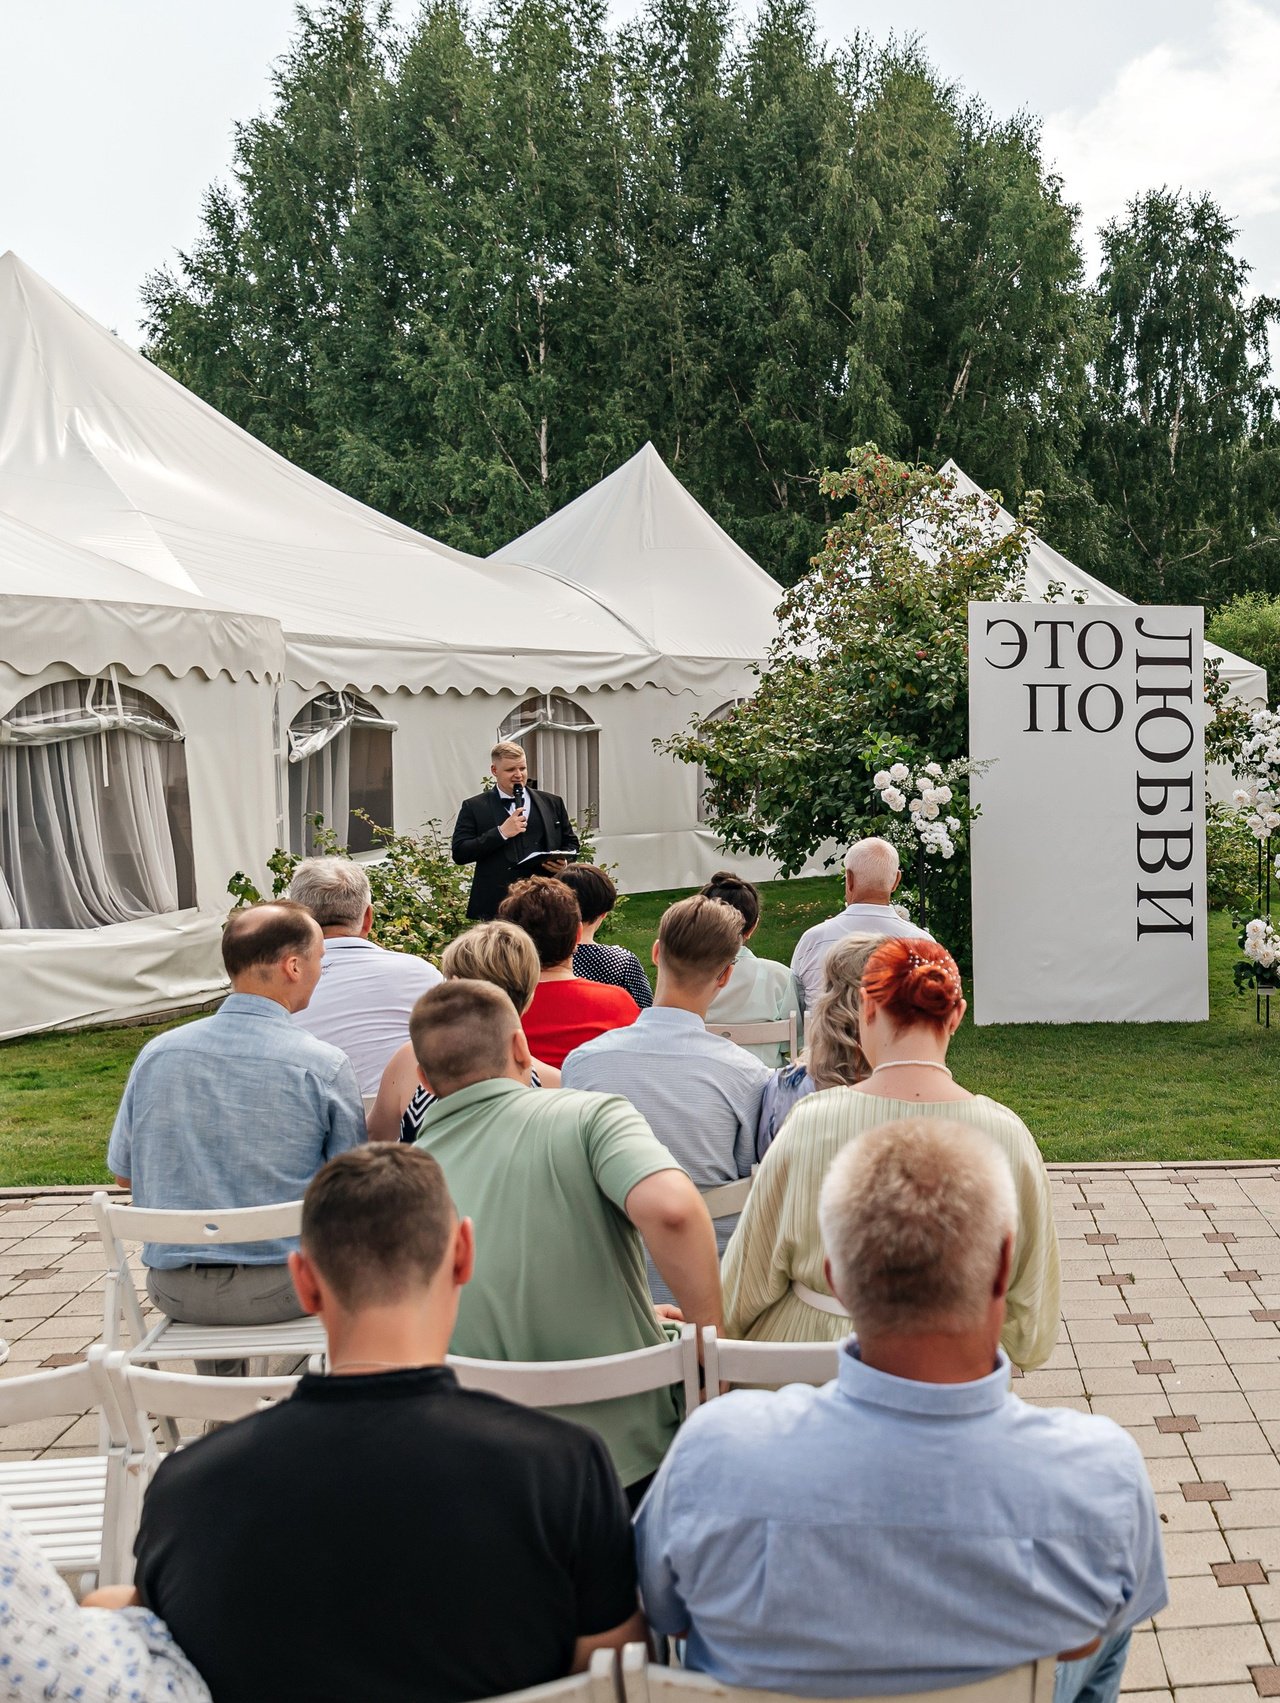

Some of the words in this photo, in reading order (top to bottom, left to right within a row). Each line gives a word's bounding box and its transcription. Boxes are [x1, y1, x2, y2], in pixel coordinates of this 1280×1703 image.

[984, 619, 1124, 671] ЭТО
[1022, 683, 1124, 733] ПО
[1135, 616, 1195, 942] ЛЮБВИ
